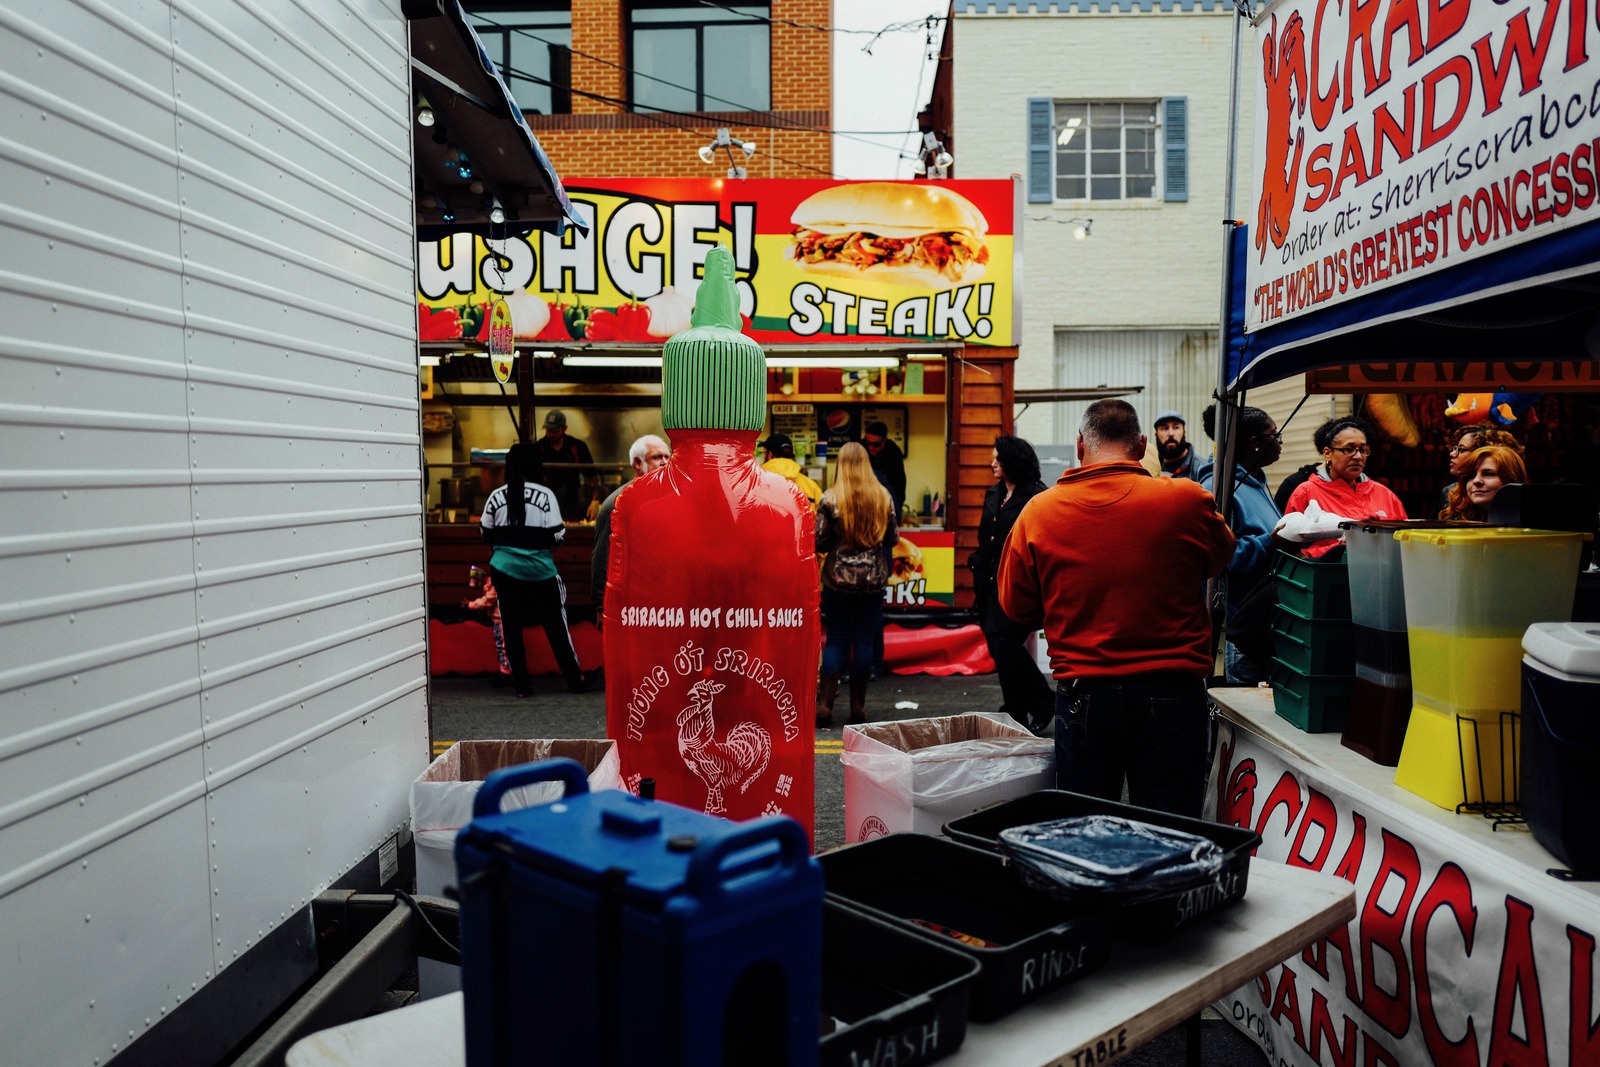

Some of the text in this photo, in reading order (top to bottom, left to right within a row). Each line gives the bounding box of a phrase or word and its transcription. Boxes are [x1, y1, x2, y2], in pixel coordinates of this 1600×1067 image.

[1303, 0, 1600, 213] SANDWI
[1282, 220, 1329, 265] order
[1335, 201, 1362, 238] at:
[1285, 249, 1349, 314] WORLD'S
[1350, 199, 1453, 289] GREATEST
[787, 282, 995, 338] STEAK!
[621, 606, 803, 629] SRIRACHA HOT CHILI SAUCE
[714, 647, 799, 742] SRIRACHA
[1022, 945, 1087, 994] RINSE
[1072, 1028, 1127, 1067] TABLE
